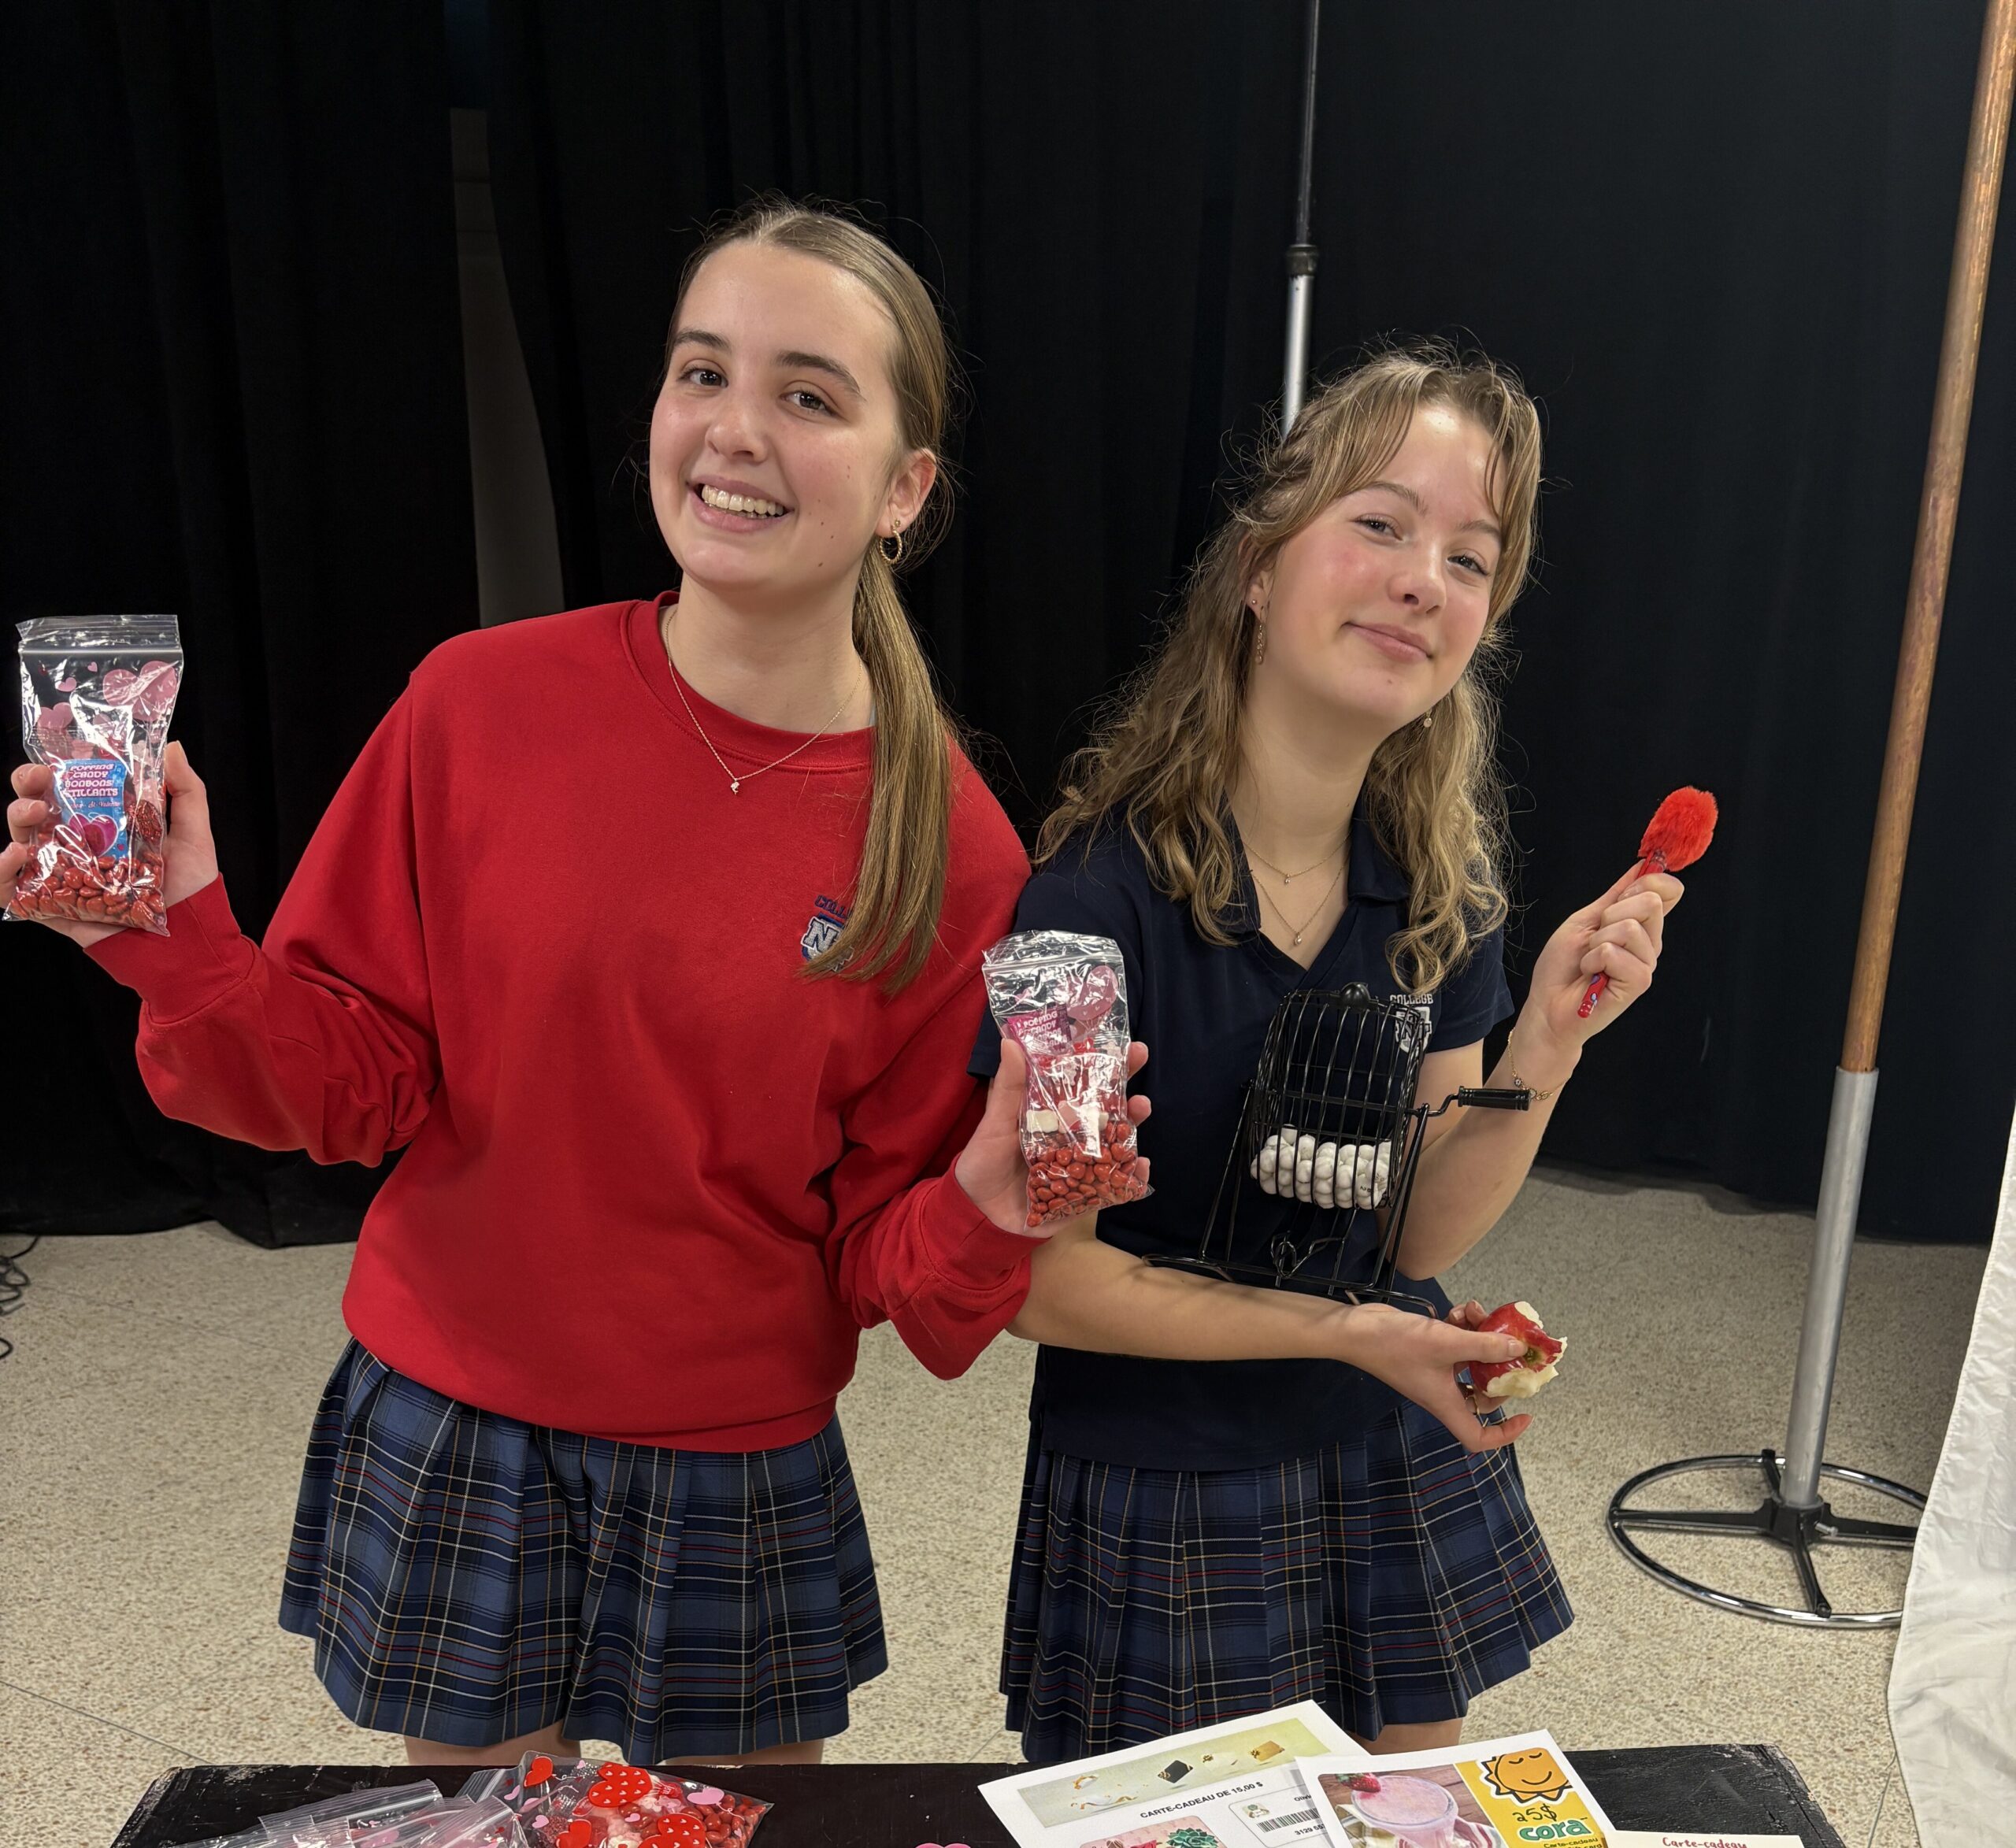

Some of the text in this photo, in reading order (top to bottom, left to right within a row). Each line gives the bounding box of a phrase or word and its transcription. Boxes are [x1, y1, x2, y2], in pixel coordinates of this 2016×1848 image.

[63, 788, 118, 798] TILLANTS
[814, 894, 849, 920] COLL
[1023, 1011, 1058, 1028] POPPING
[1140, 1794, 1216, 1818] CARTE-CADEAU
[1232, 1782, 1255, 1794] 15,00
[1512, 1803, 1557, 1822] 25$
[1294, 1826, 1314, 1835] 3129
[1519, 1820, 1592, 1841] cora
[1544, 1838, 1599, 1848] Carte-cadeau
[1662, 1837, 1747, 1848] Carte-cadeau
